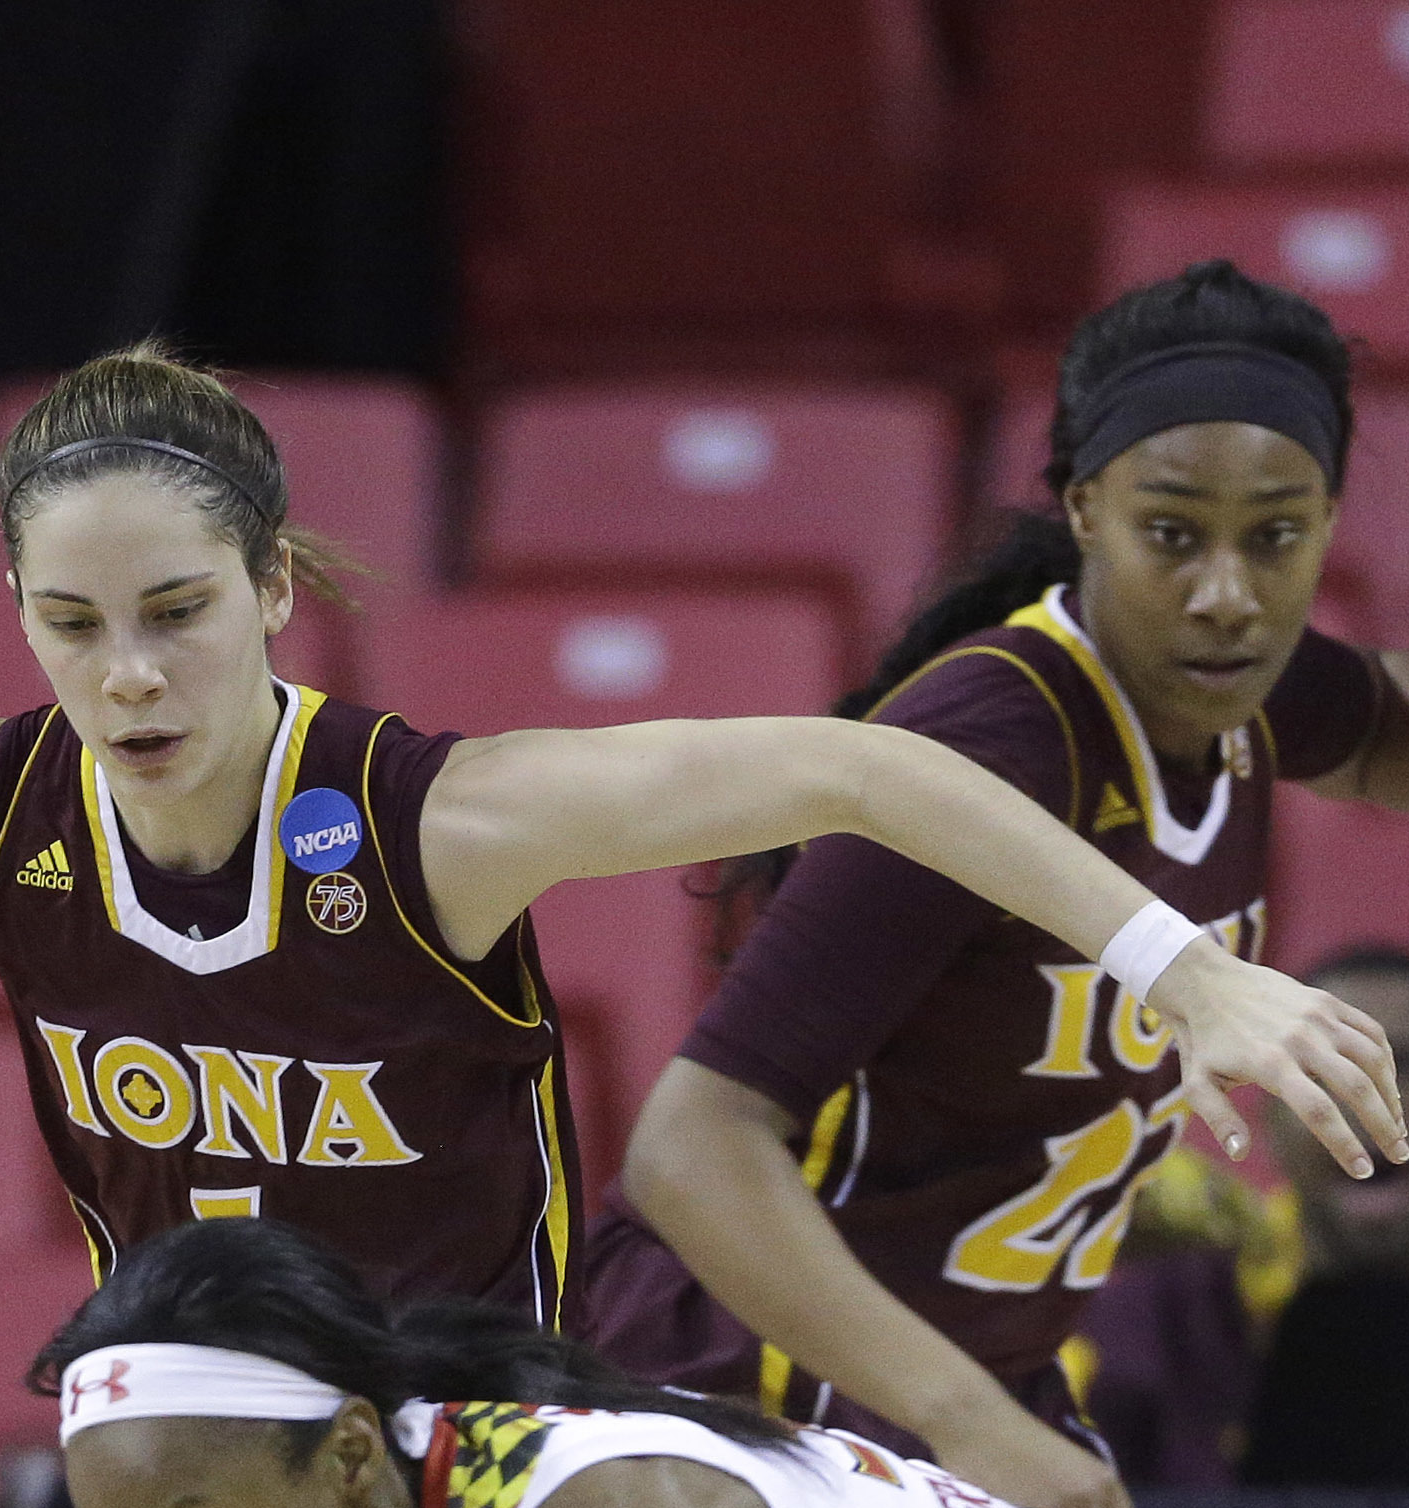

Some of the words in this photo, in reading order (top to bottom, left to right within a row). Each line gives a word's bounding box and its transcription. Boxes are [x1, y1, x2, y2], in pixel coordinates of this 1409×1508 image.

[293, 821, 360, 857] NCAA
[315, 884, 358, 922] 75
[35, 1016, 424, 1167] IONA
